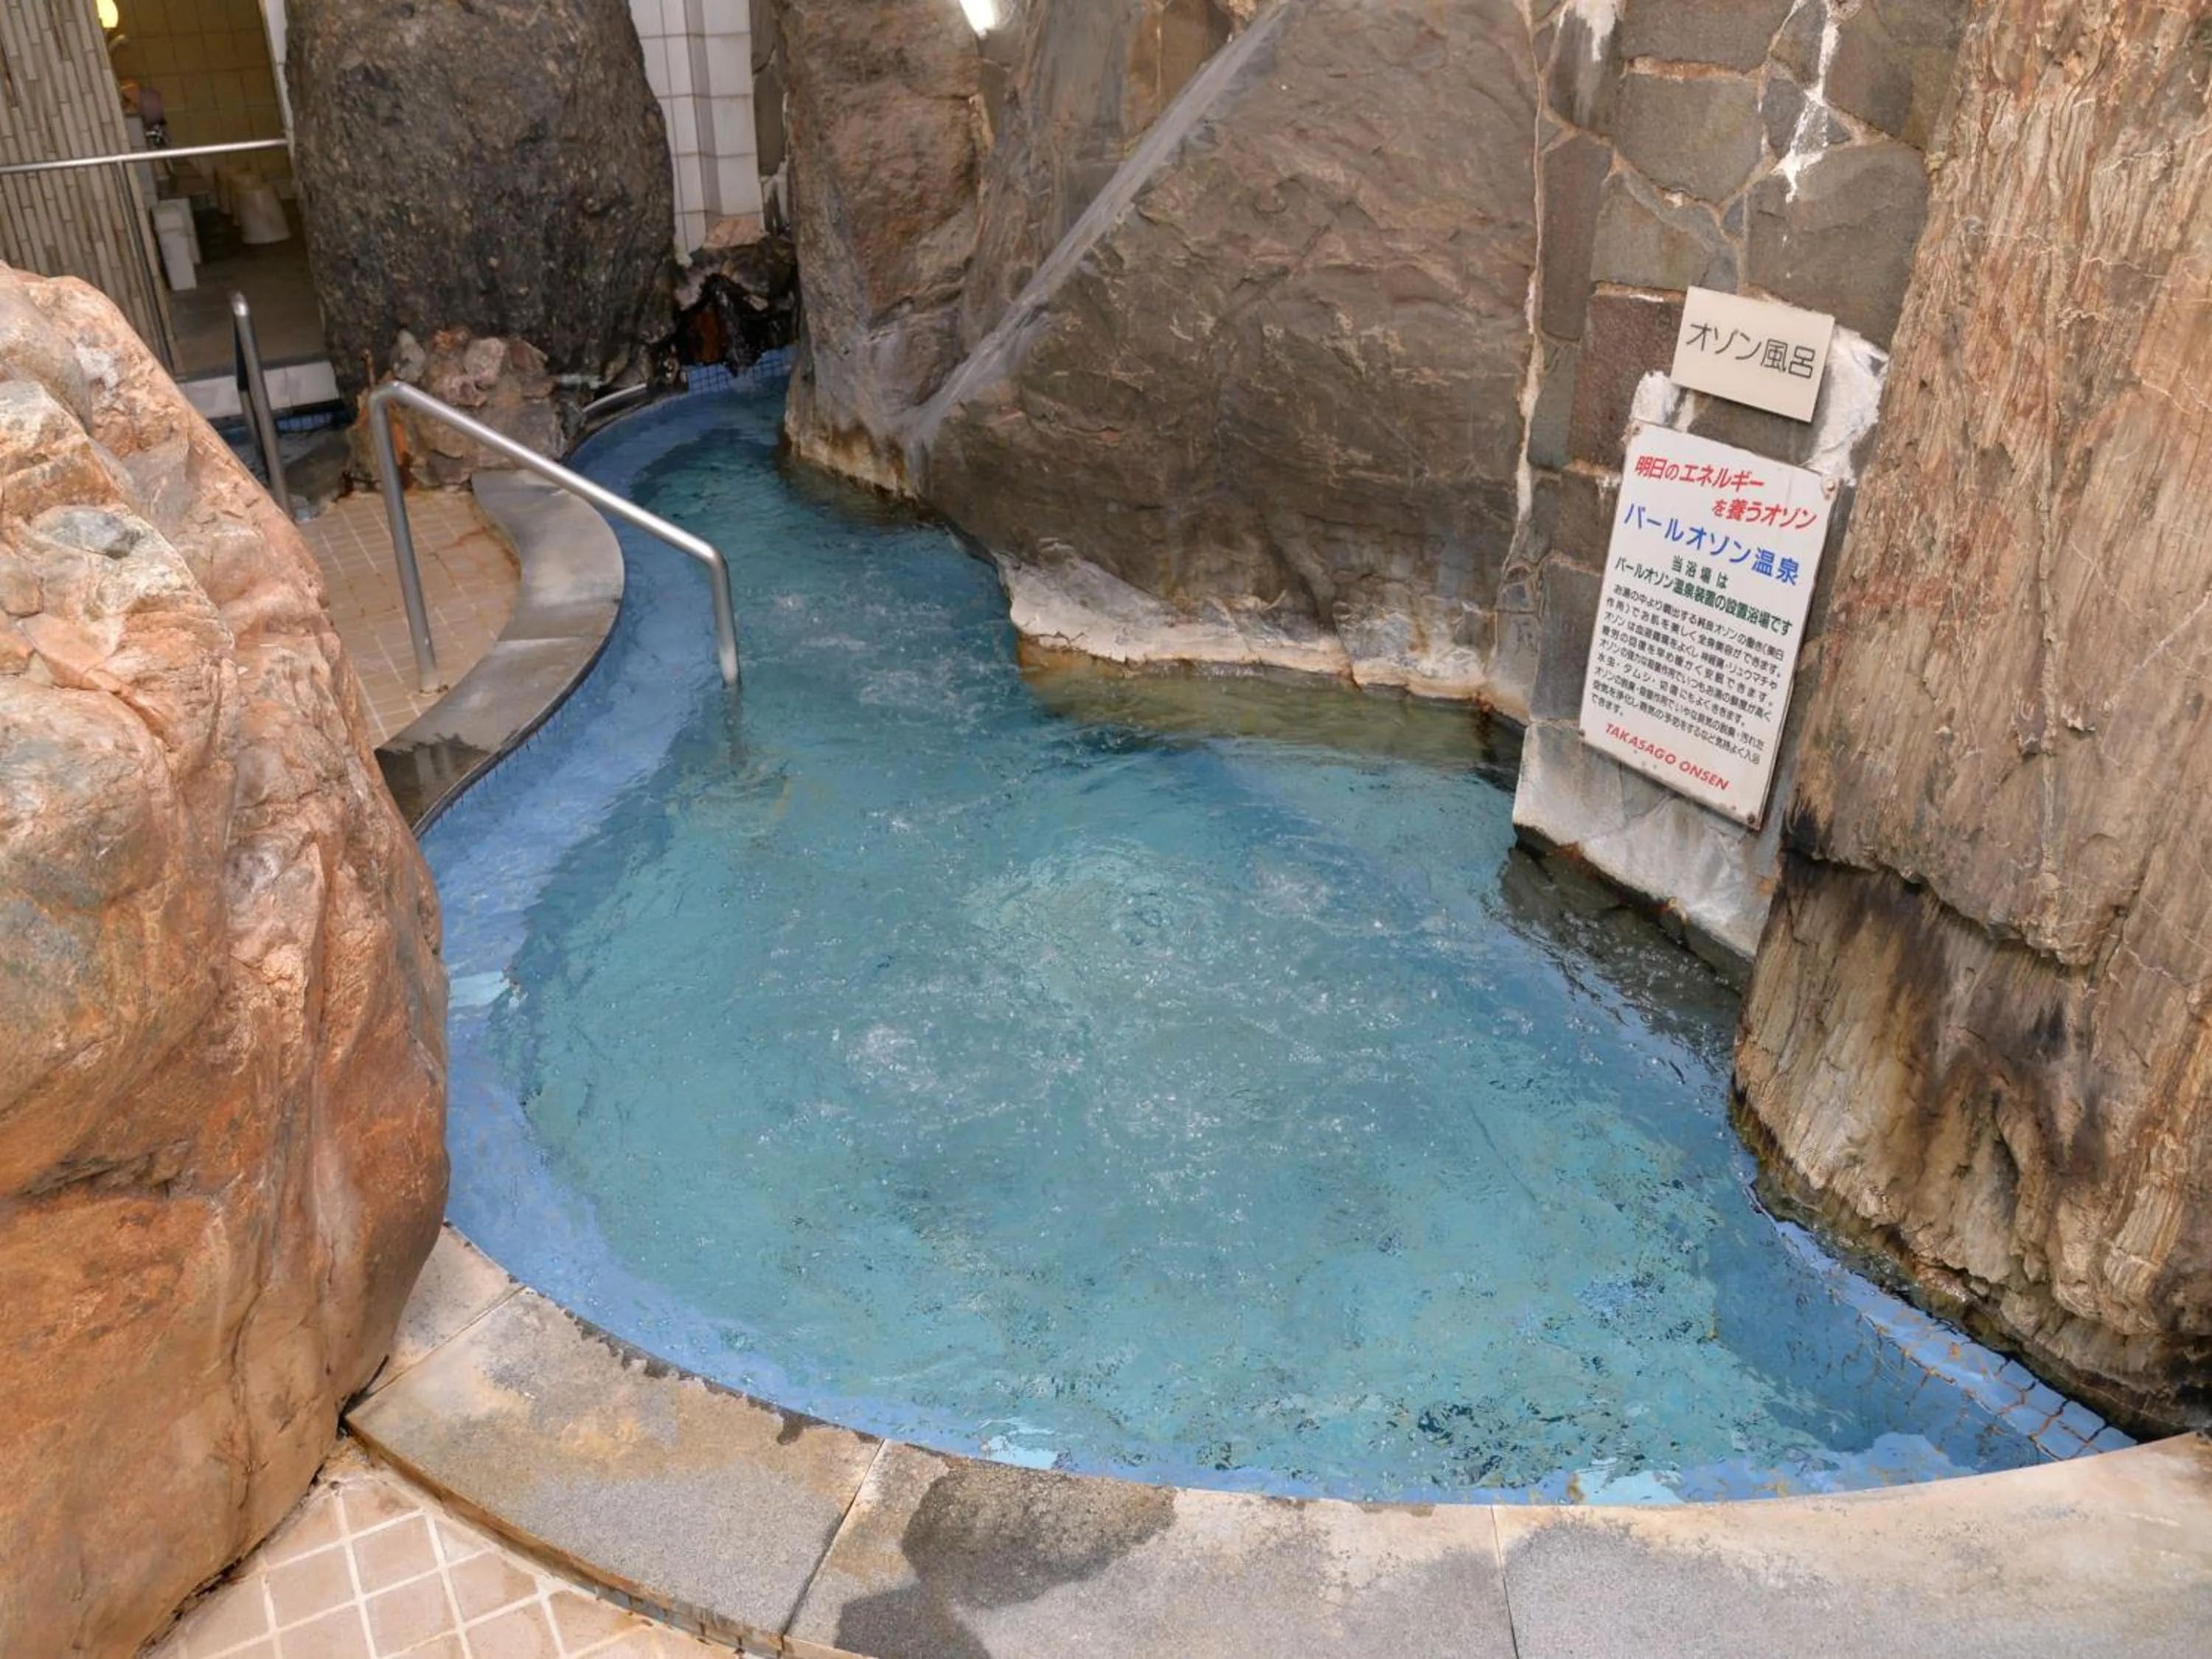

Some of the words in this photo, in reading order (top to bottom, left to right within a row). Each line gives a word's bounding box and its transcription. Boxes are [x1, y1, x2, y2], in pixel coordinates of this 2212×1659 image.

[1686, 322, 1816, 380] オゾン風呂
[1635, 455, 1765, 492] 明日のエネルギー
[1711, 498, 1818, 530] を養うオゾン
[1606, 723, 1676, 765] TAKASAGO
[1679, 760, 1728, 790] ONSEN
